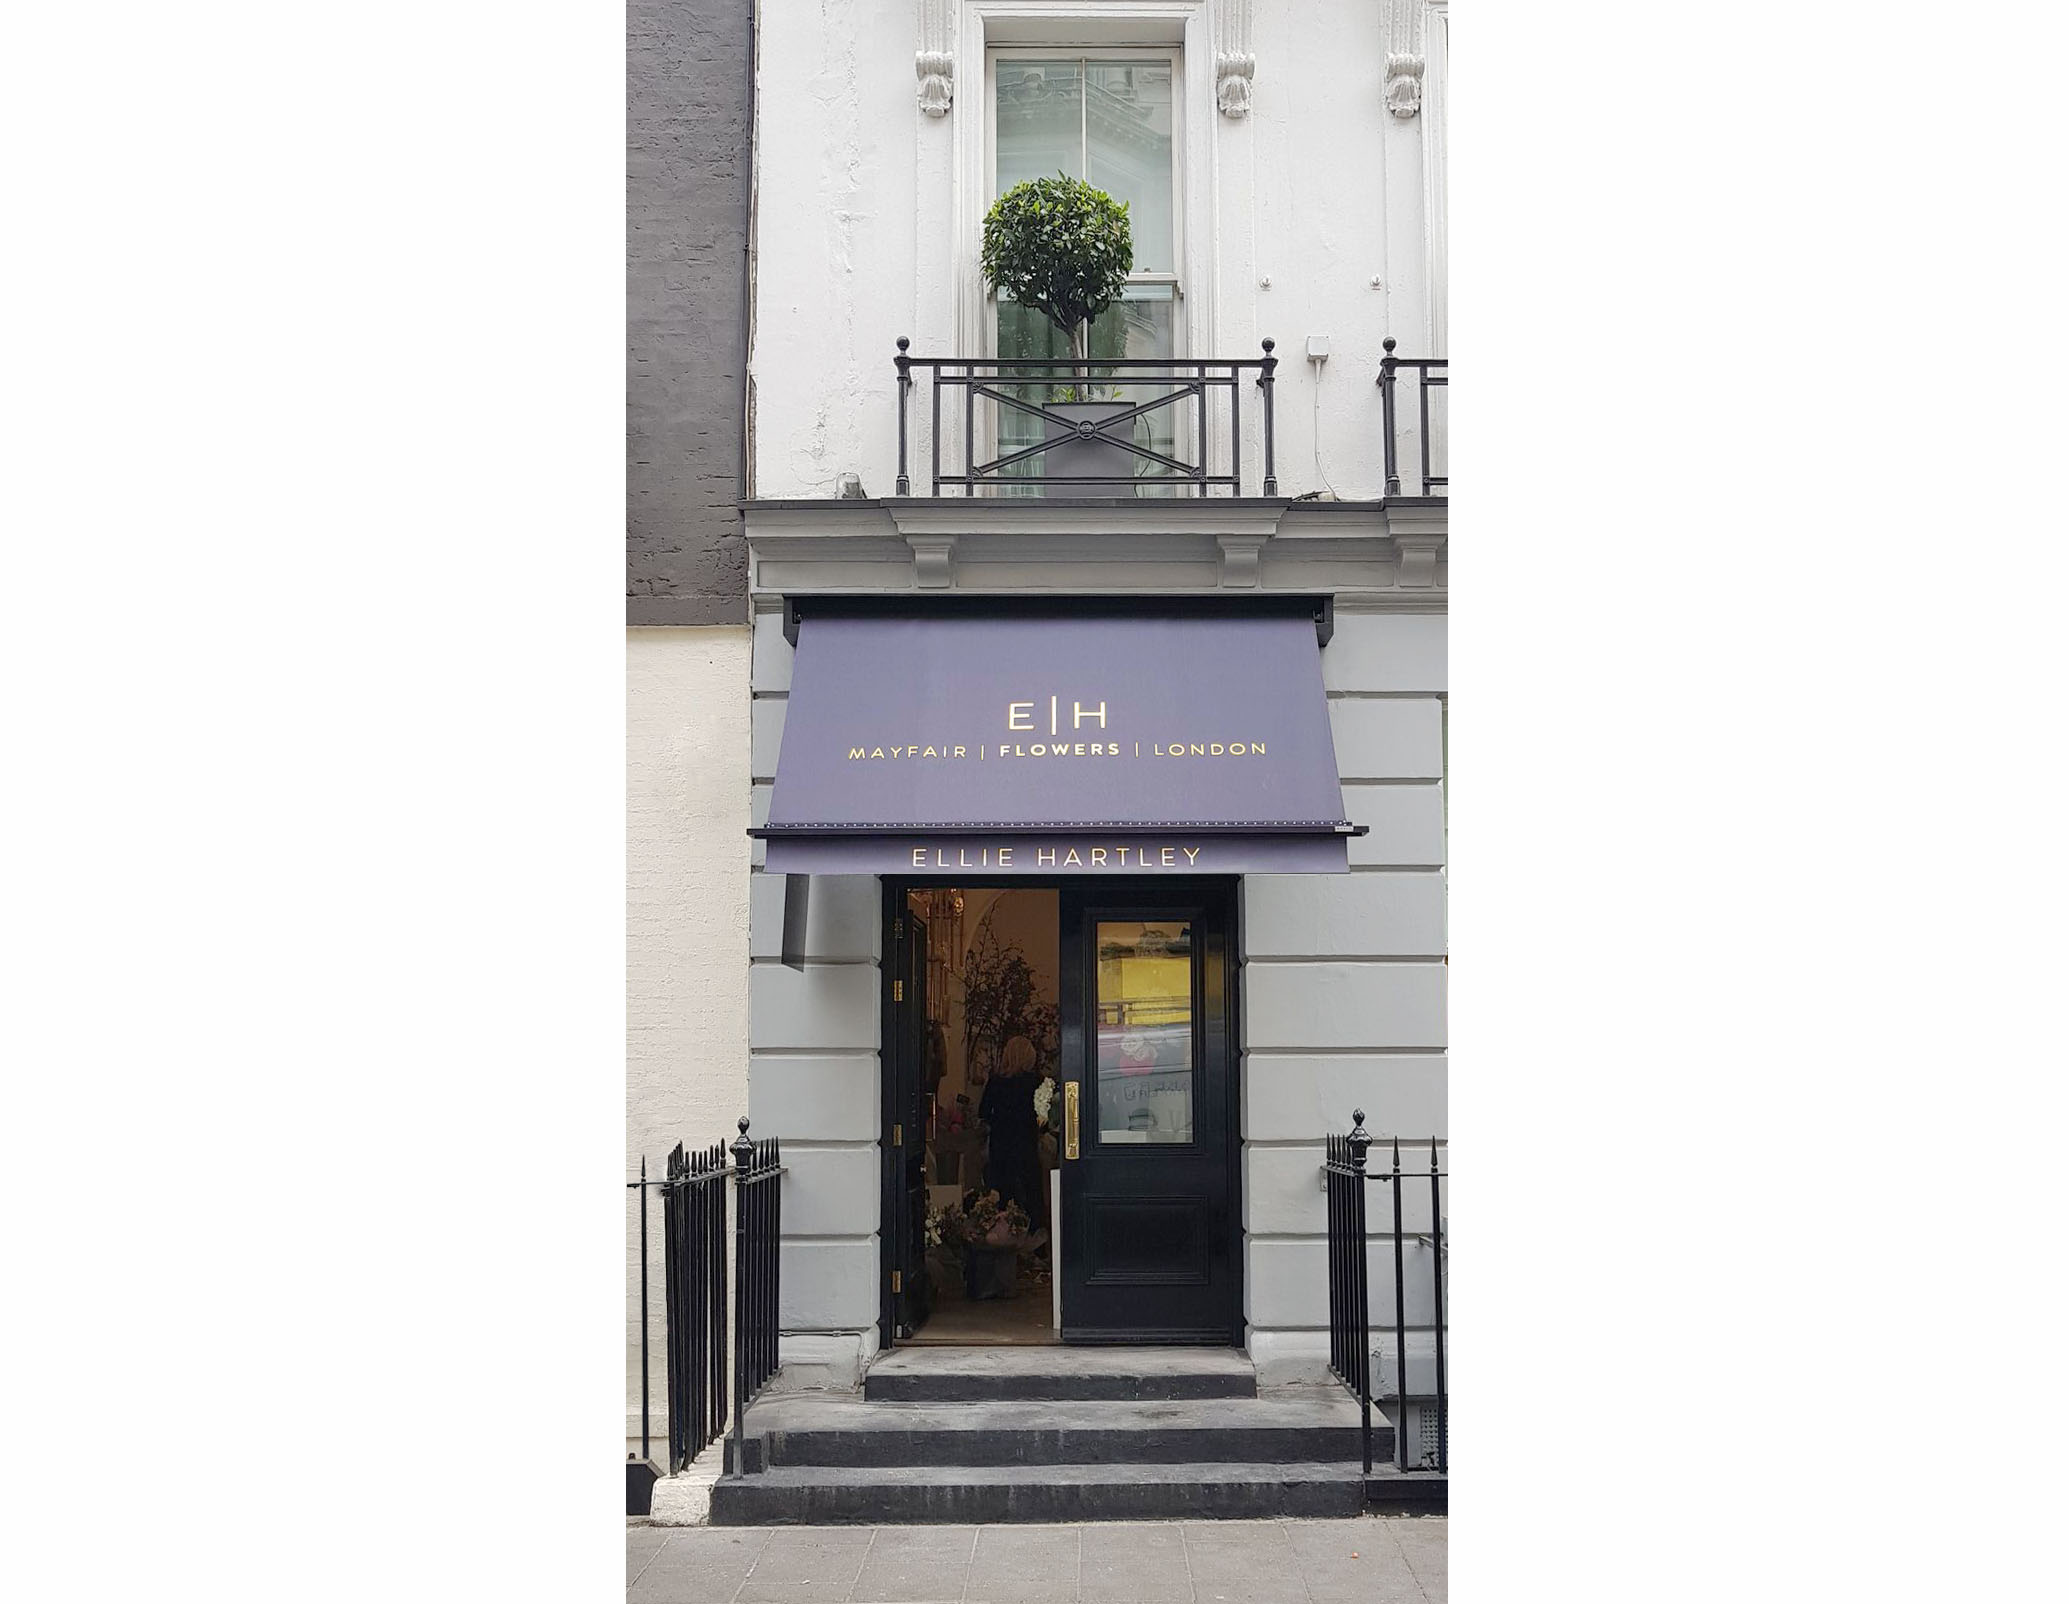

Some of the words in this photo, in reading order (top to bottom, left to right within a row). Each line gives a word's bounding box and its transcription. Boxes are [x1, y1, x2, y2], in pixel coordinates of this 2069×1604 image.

[848, 744, 967, 760] MAYFAIR
[1000, 742, 1121, 758] FLOWERS
[1154, 742, 1266, 757] LONDON
[912, 848, 1013, 867] ELLIE
[1037, 847, 1200, 867] HARTLEY
